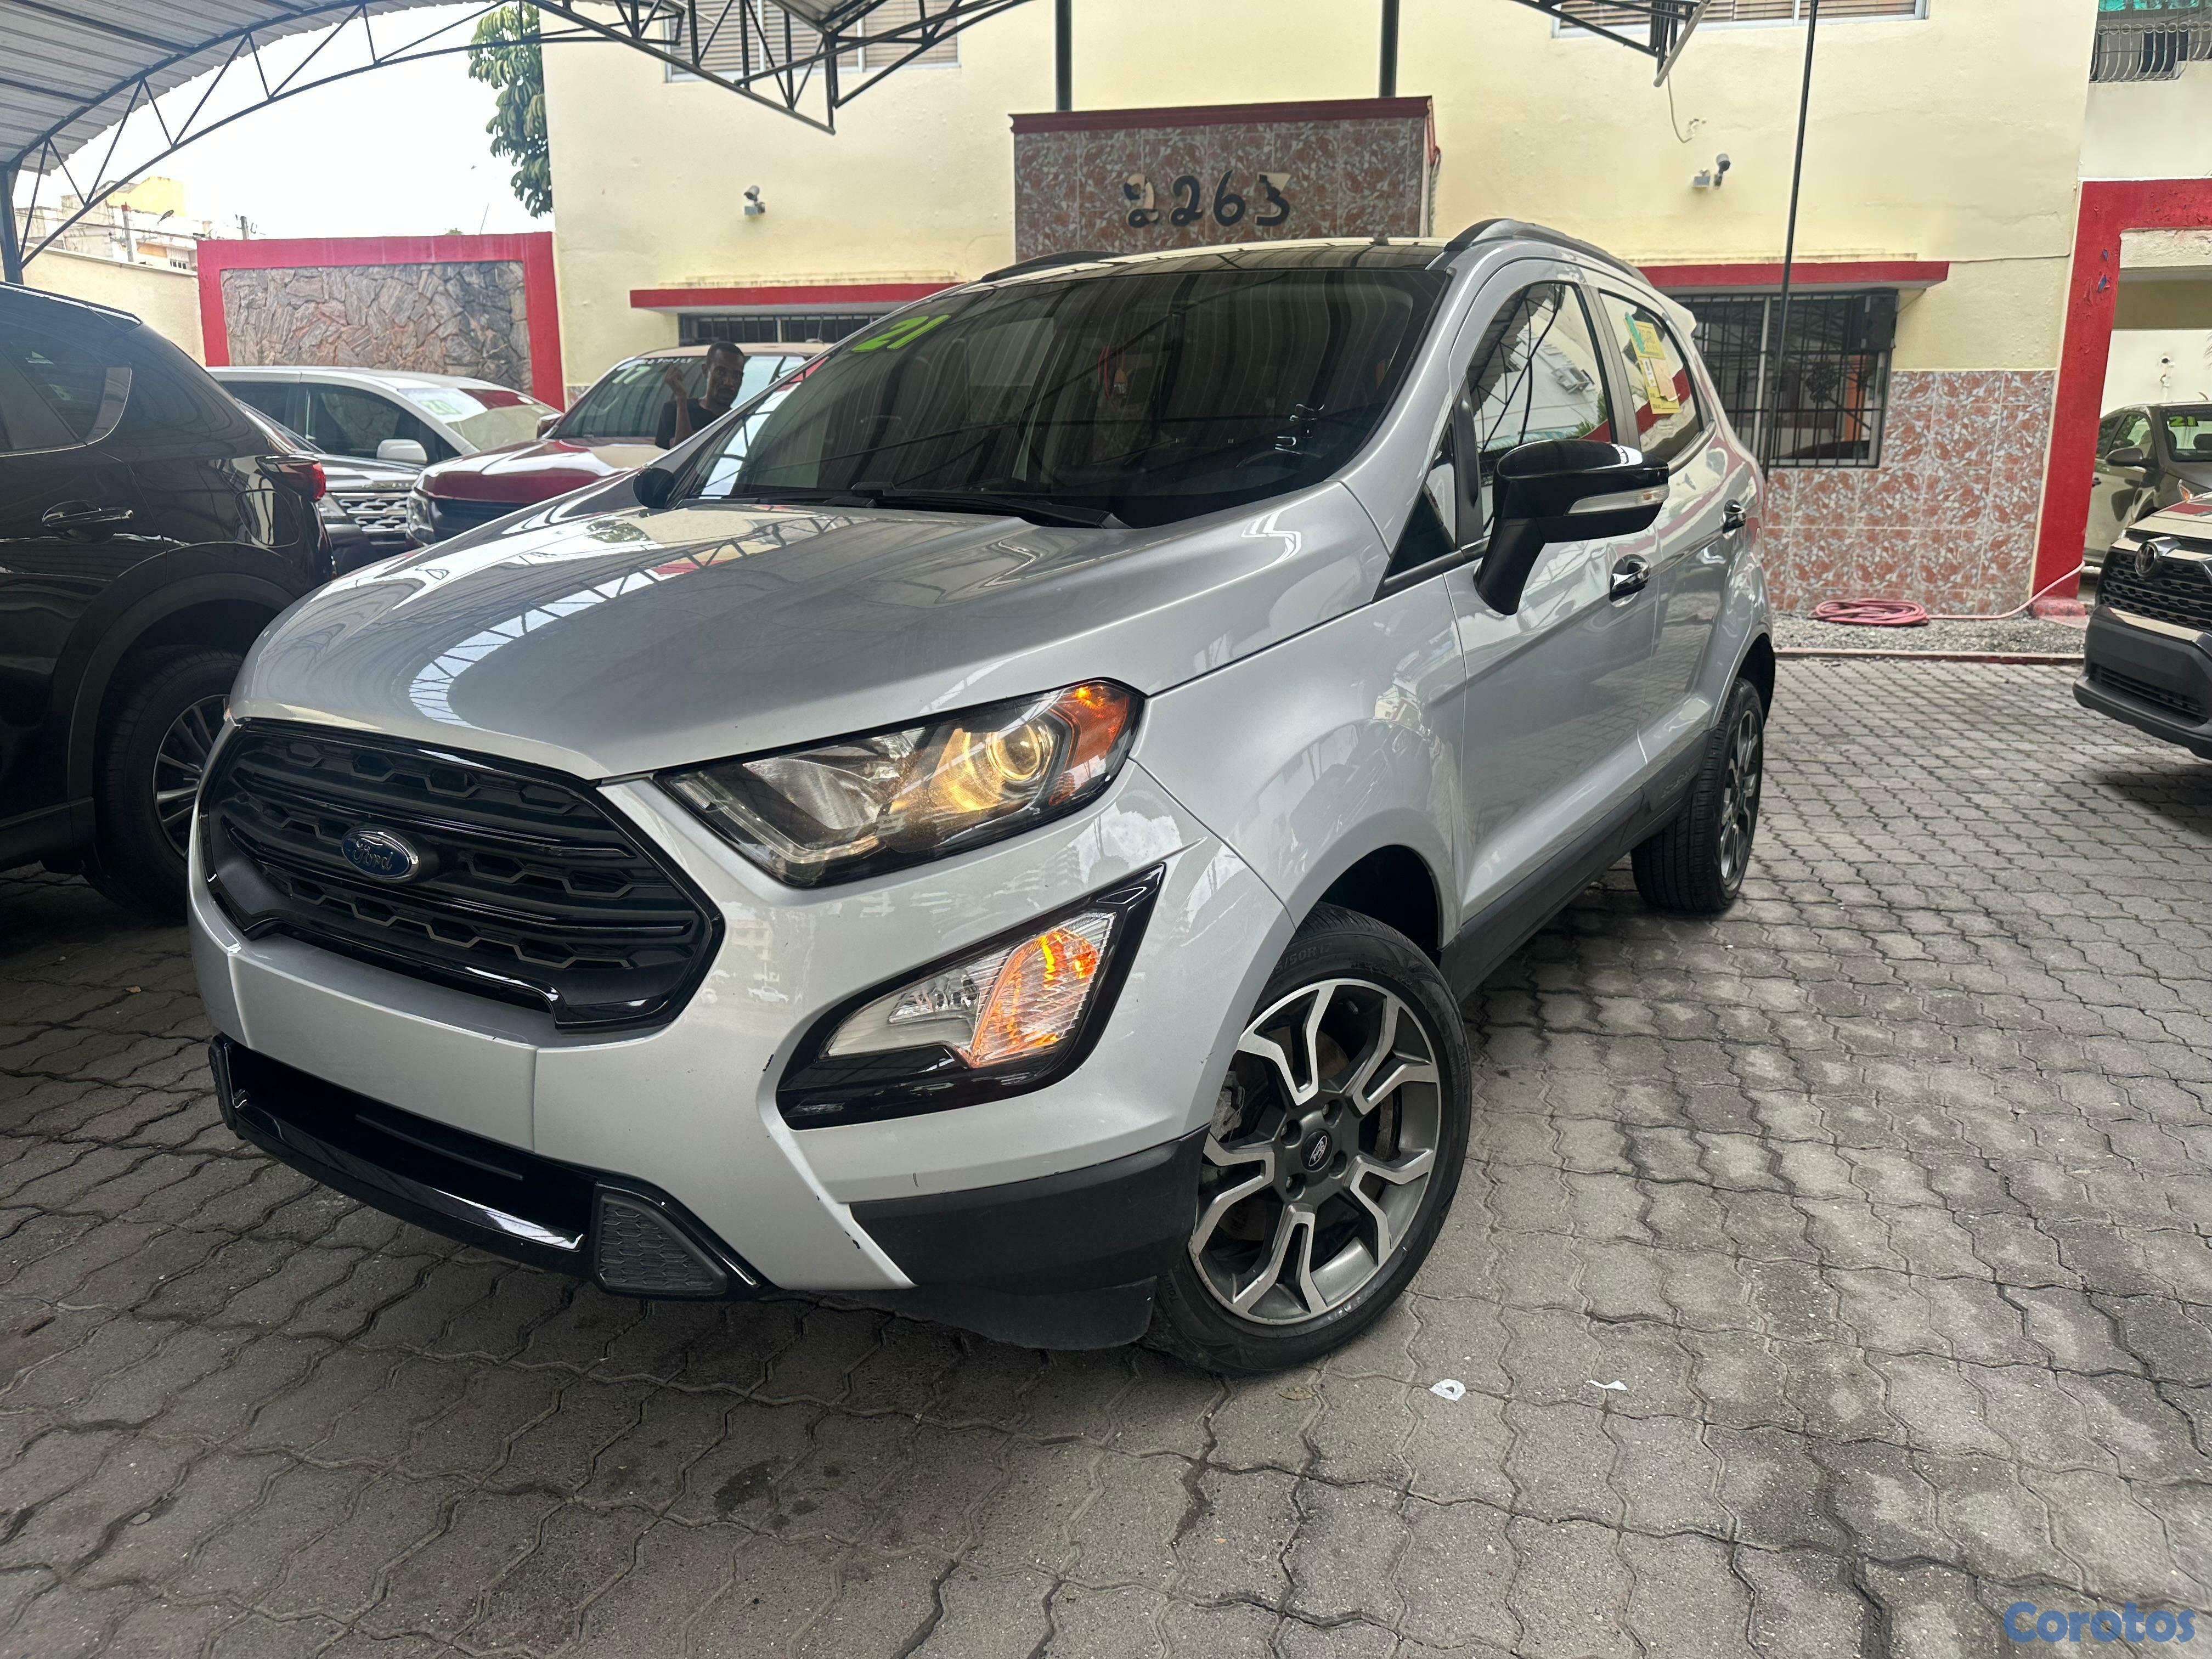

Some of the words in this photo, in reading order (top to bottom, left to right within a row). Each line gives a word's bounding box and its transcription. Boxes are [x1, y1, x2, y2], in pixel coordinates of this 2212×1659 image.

[1124, 170, 1291, 228] 2263
[851, 314, 951, 352] 21
[2169, 416, 2195, 426] 21
[353, 838, 393, 871] Ford
